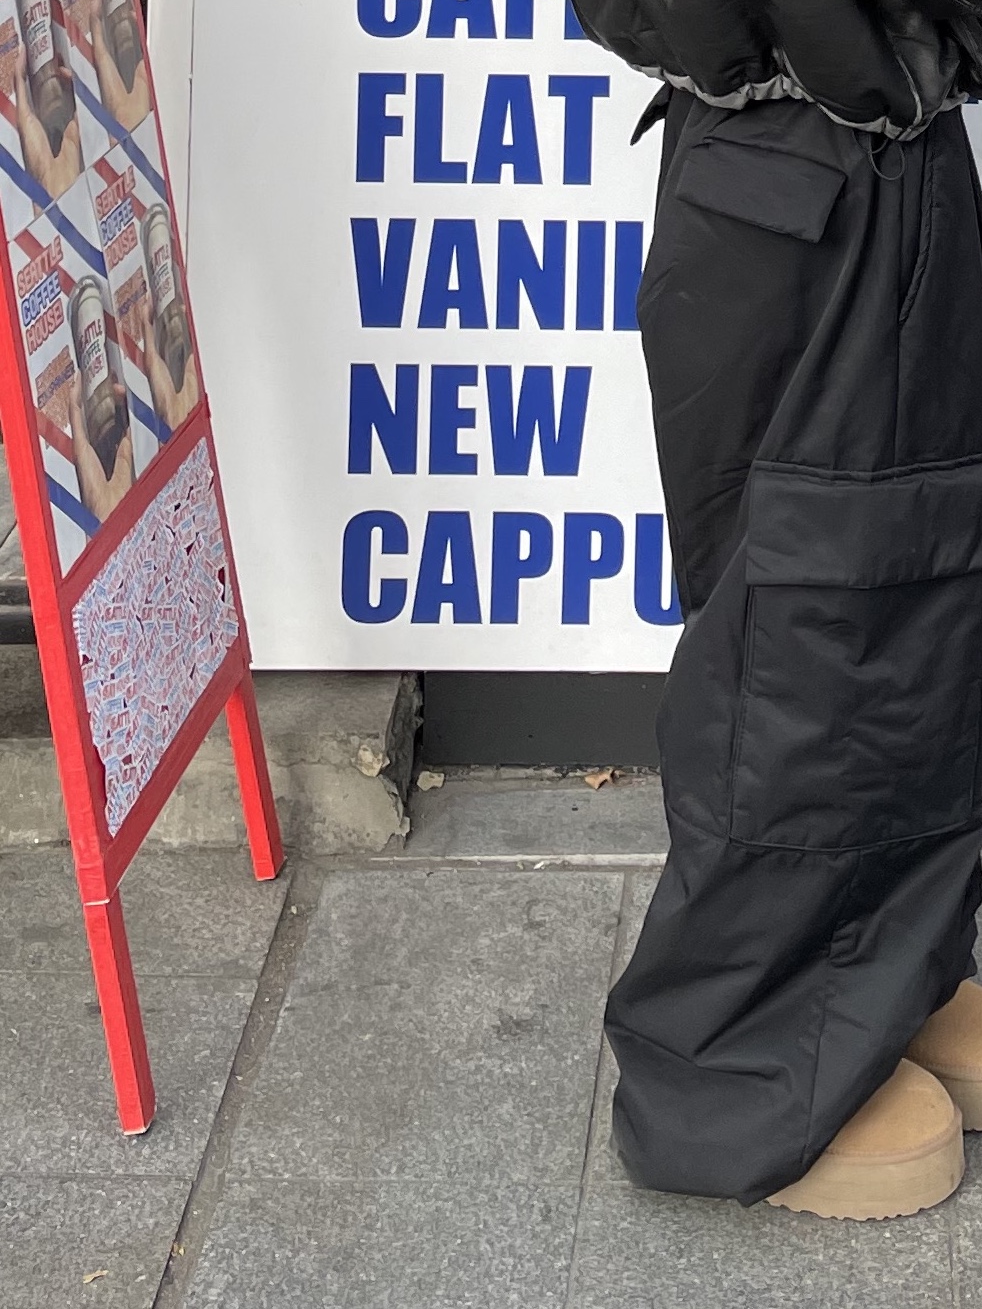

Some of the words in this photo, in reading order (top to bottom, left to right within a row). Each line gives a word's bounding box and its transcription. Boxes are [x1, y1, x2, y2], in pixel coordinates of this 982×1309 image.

[356, 73, 609, 185] FLAT
[100, 197, 135, 246] COFFEE
[21, 269, 62, 327] COFFEE
[348, 364, 592, 477] NEW
